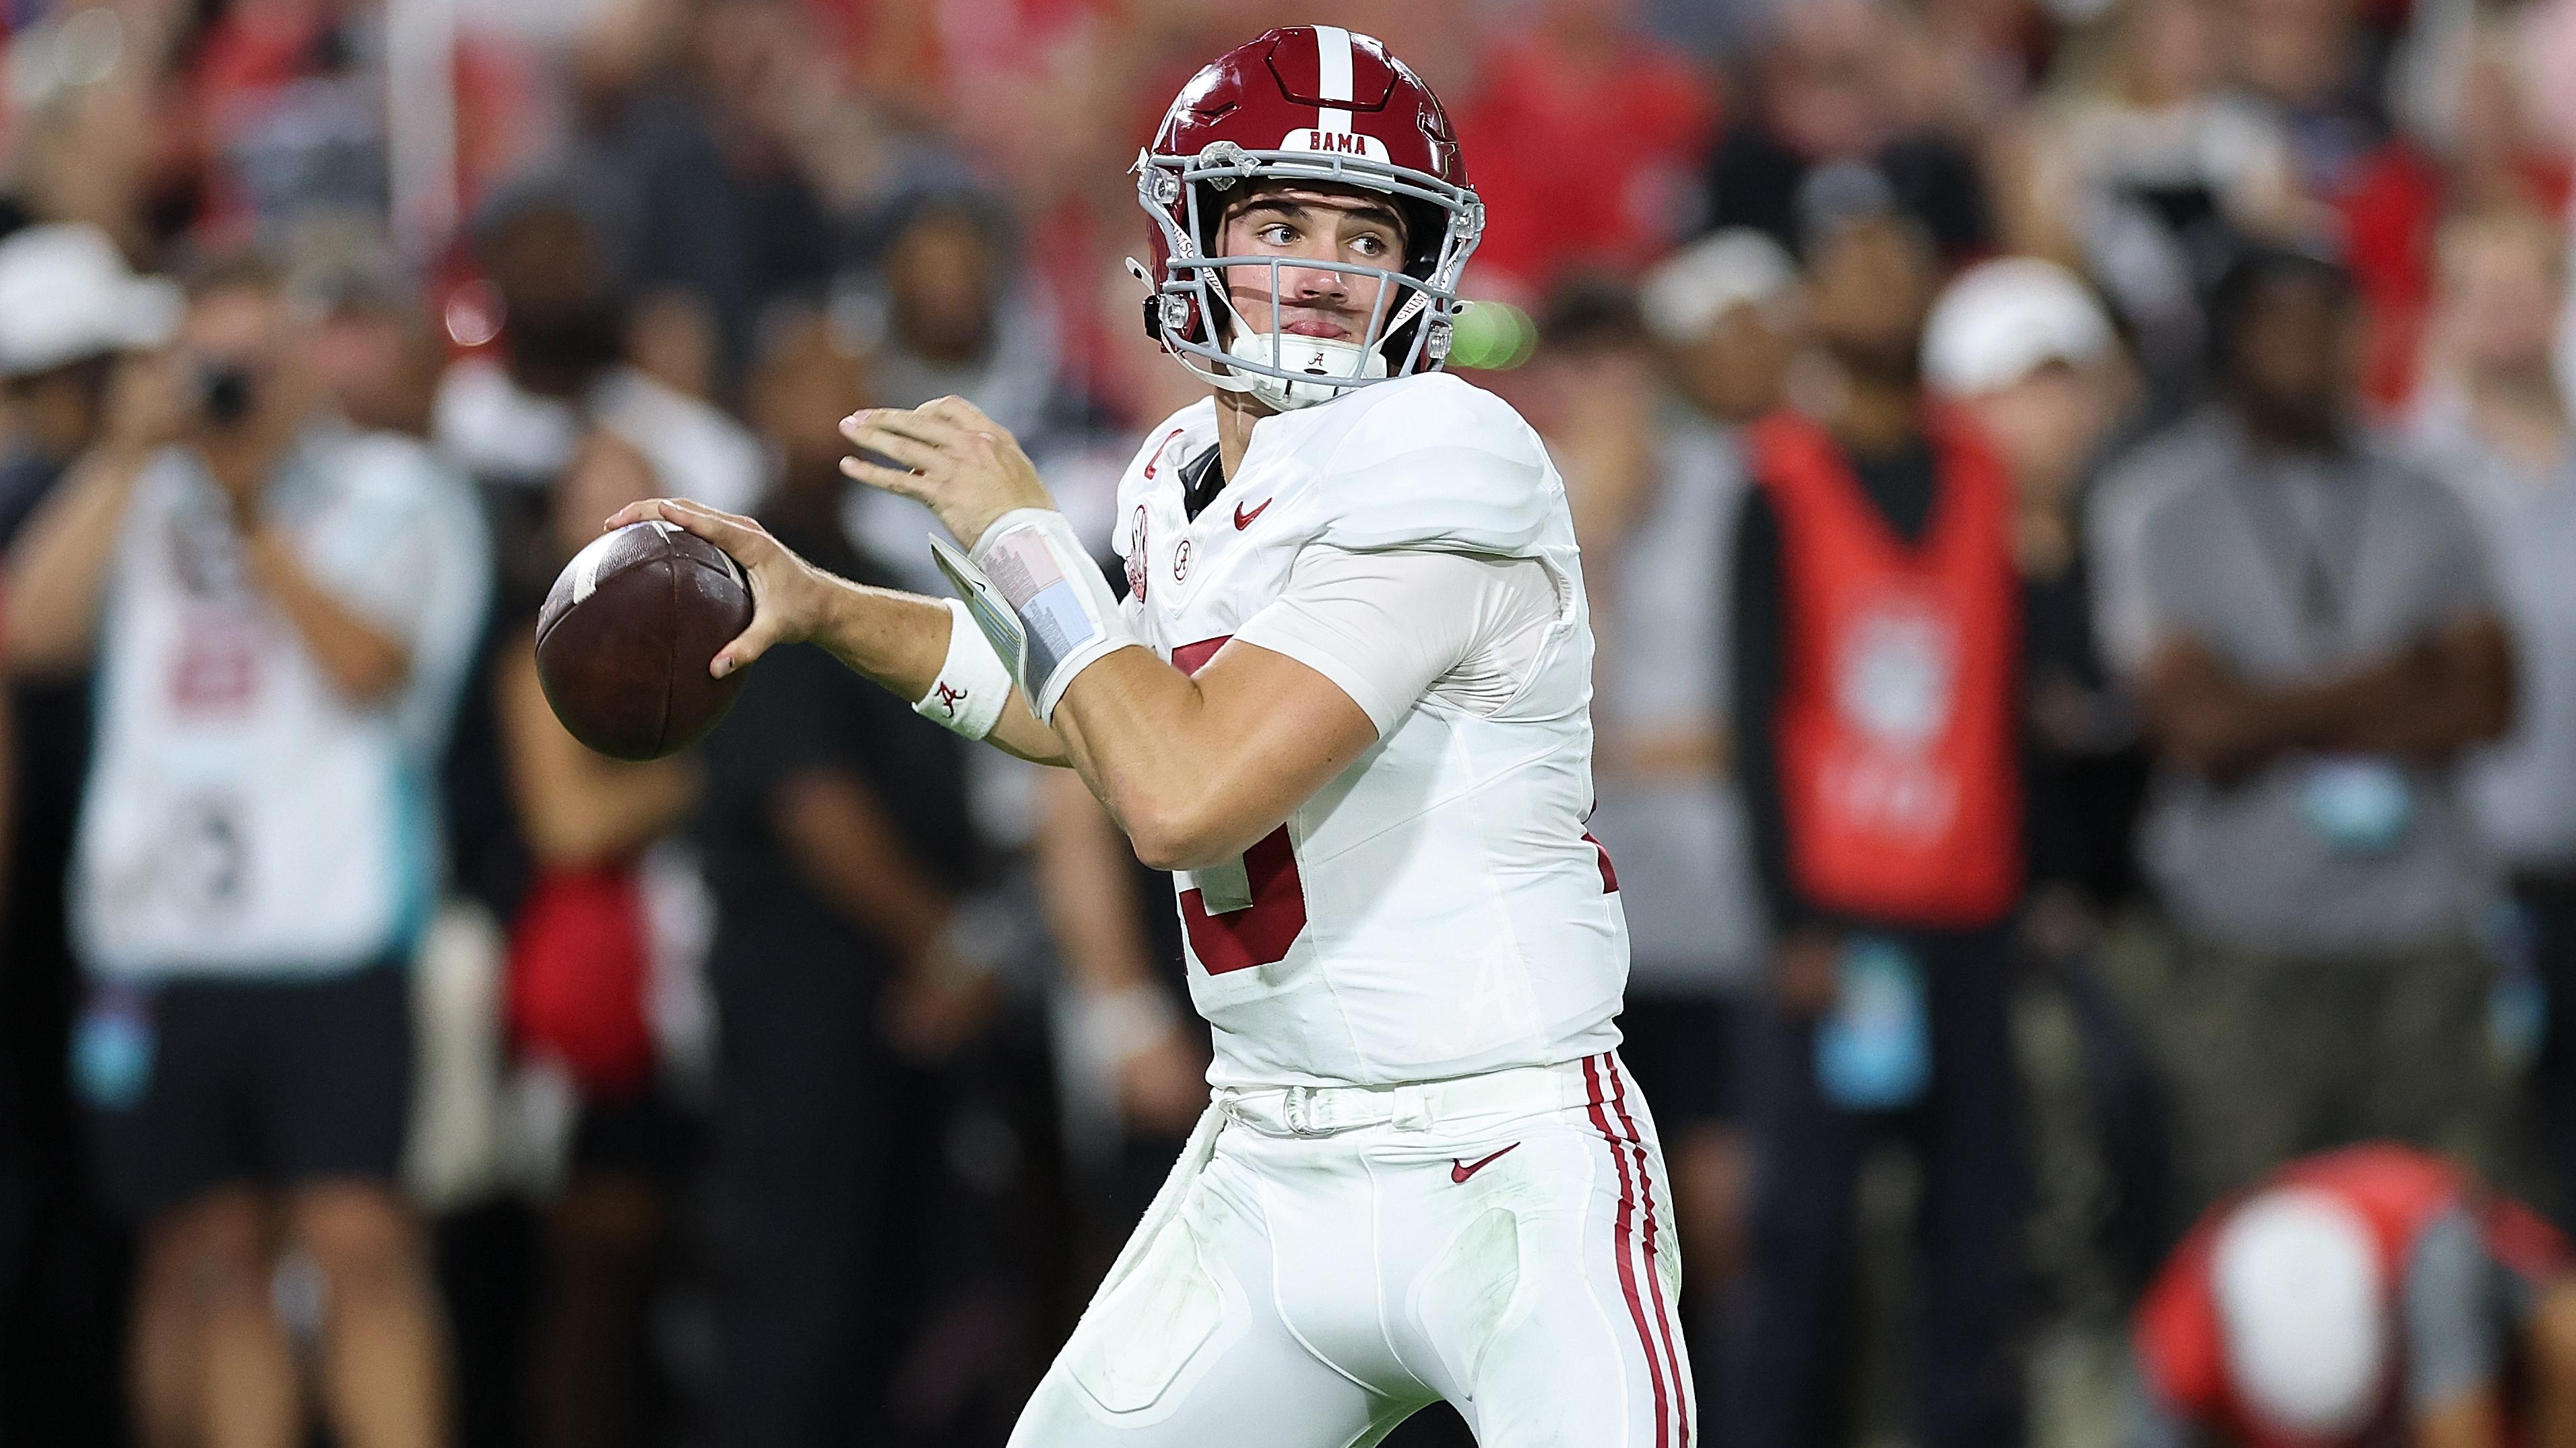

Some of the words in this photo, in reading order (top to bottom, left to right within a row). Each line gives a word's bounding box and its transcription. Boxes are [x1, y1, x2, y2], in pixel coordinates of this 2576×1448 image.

[1310, 131, 1366, 155] BAMA
[1308, 352, 1324, 367] A
[1176, 546, 1189, 572] A
[934, 681, 967, 718] A
